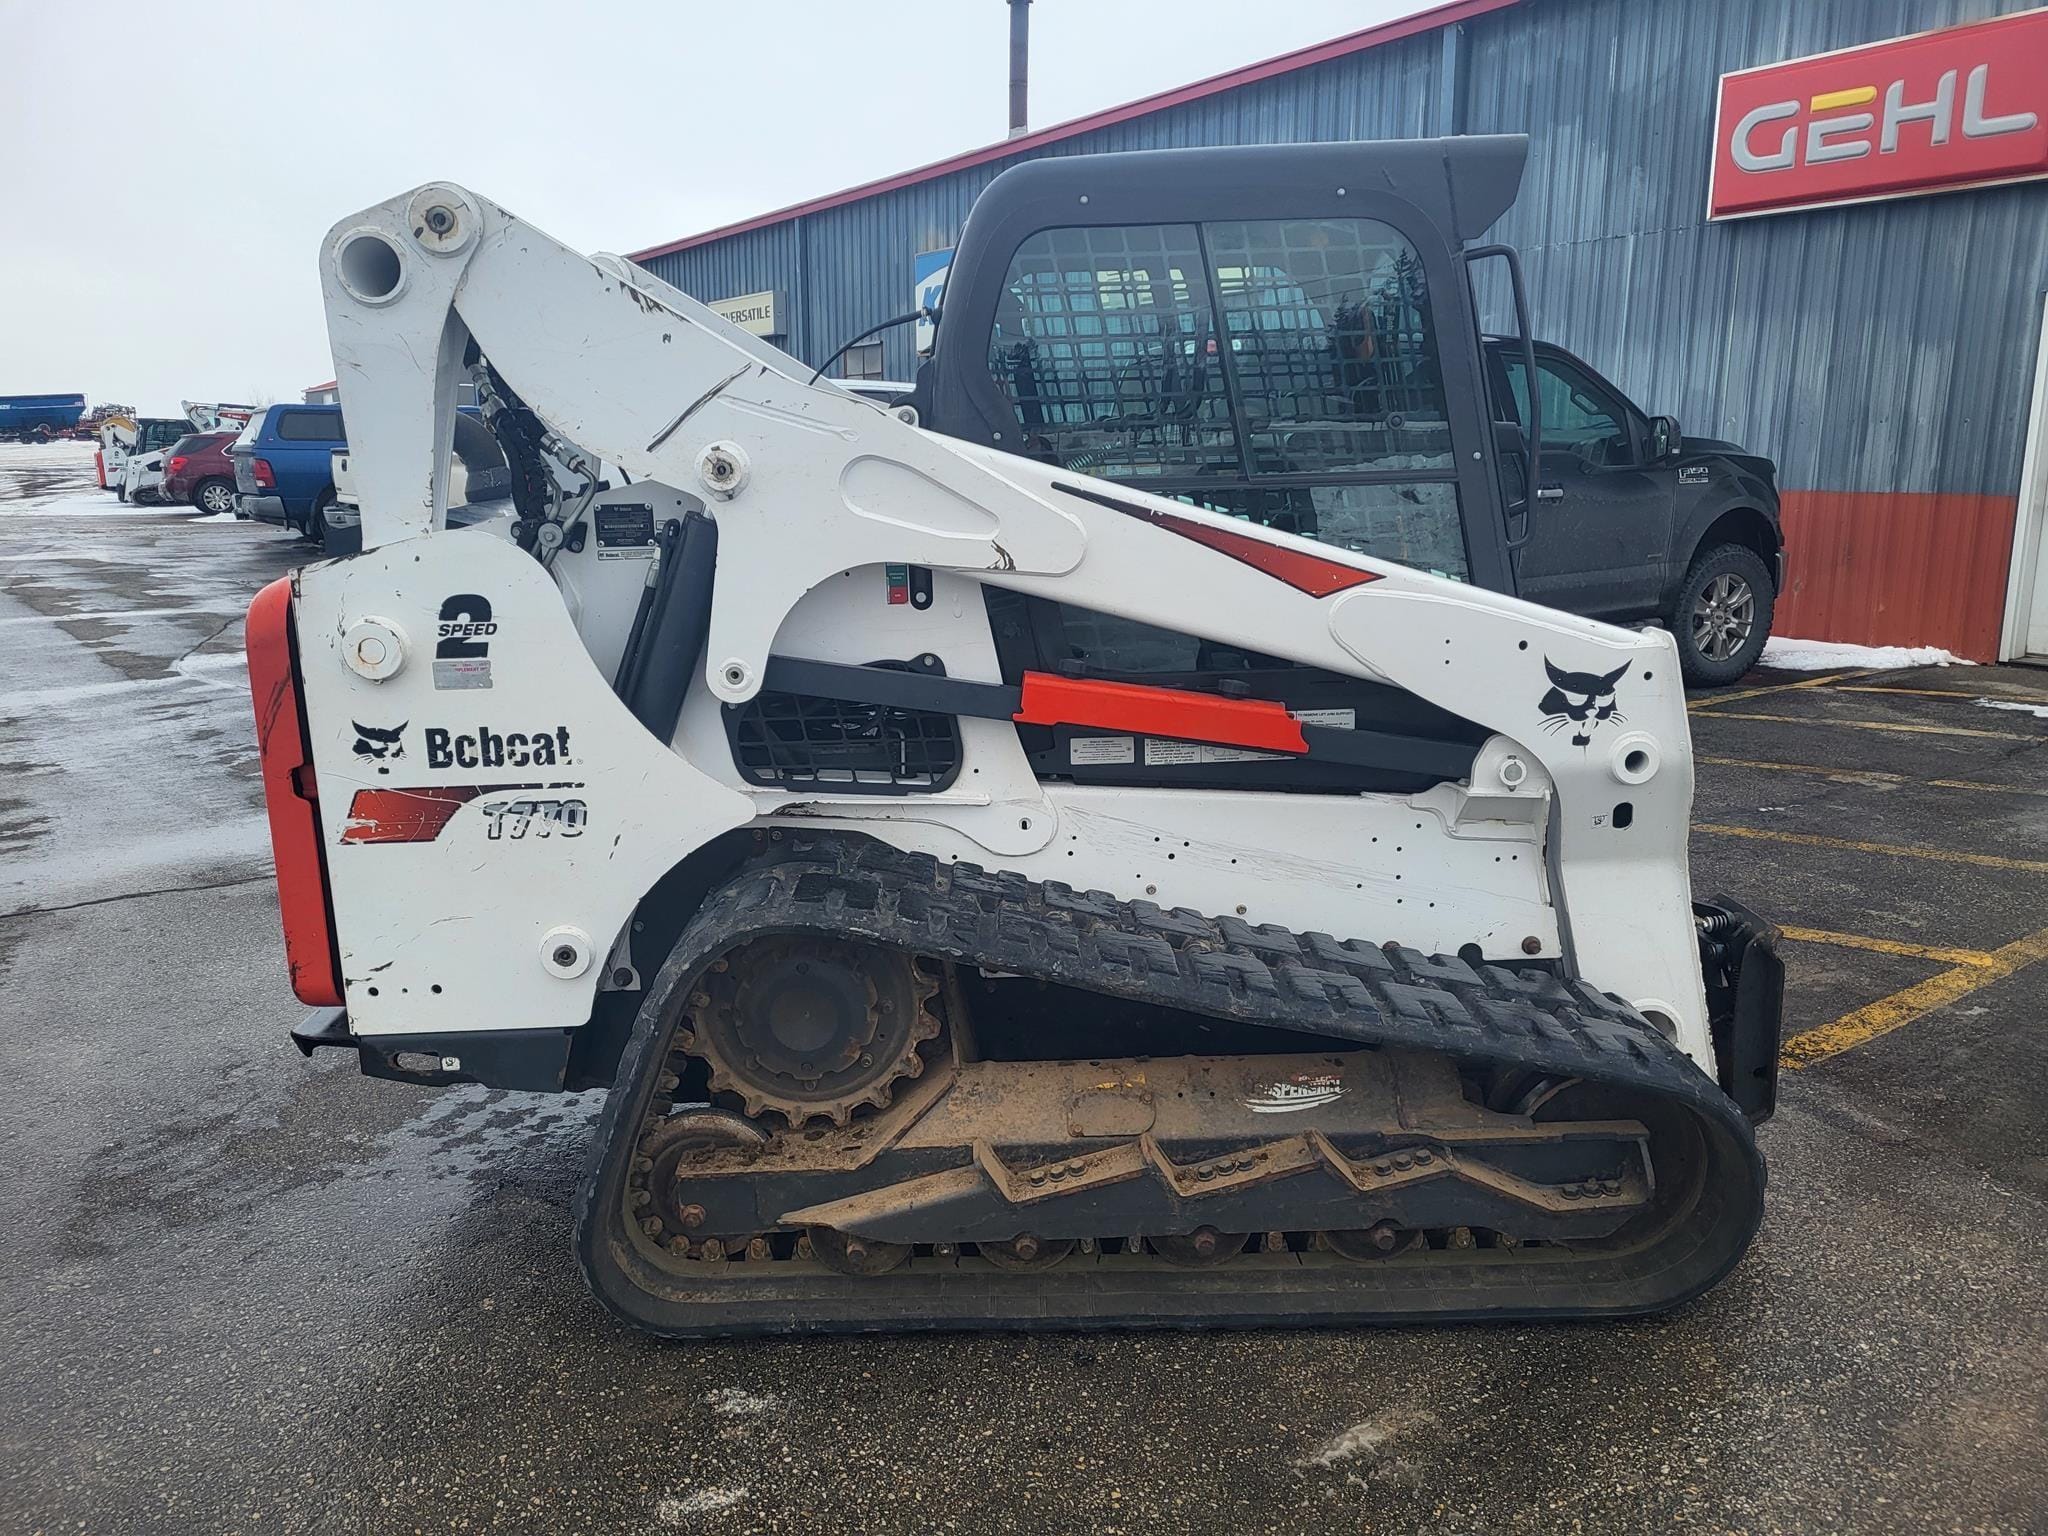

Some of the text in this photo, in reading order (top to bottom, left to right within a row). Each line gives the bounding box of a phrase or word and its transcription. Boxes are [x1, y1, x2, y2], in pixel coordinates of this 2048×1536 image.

[1731, 63, 2038, 174] GEHL
[436, 594, 493, 659] 2
[438, 623, 498, 637] SPEED
[482, 799, 588, 840] T770
